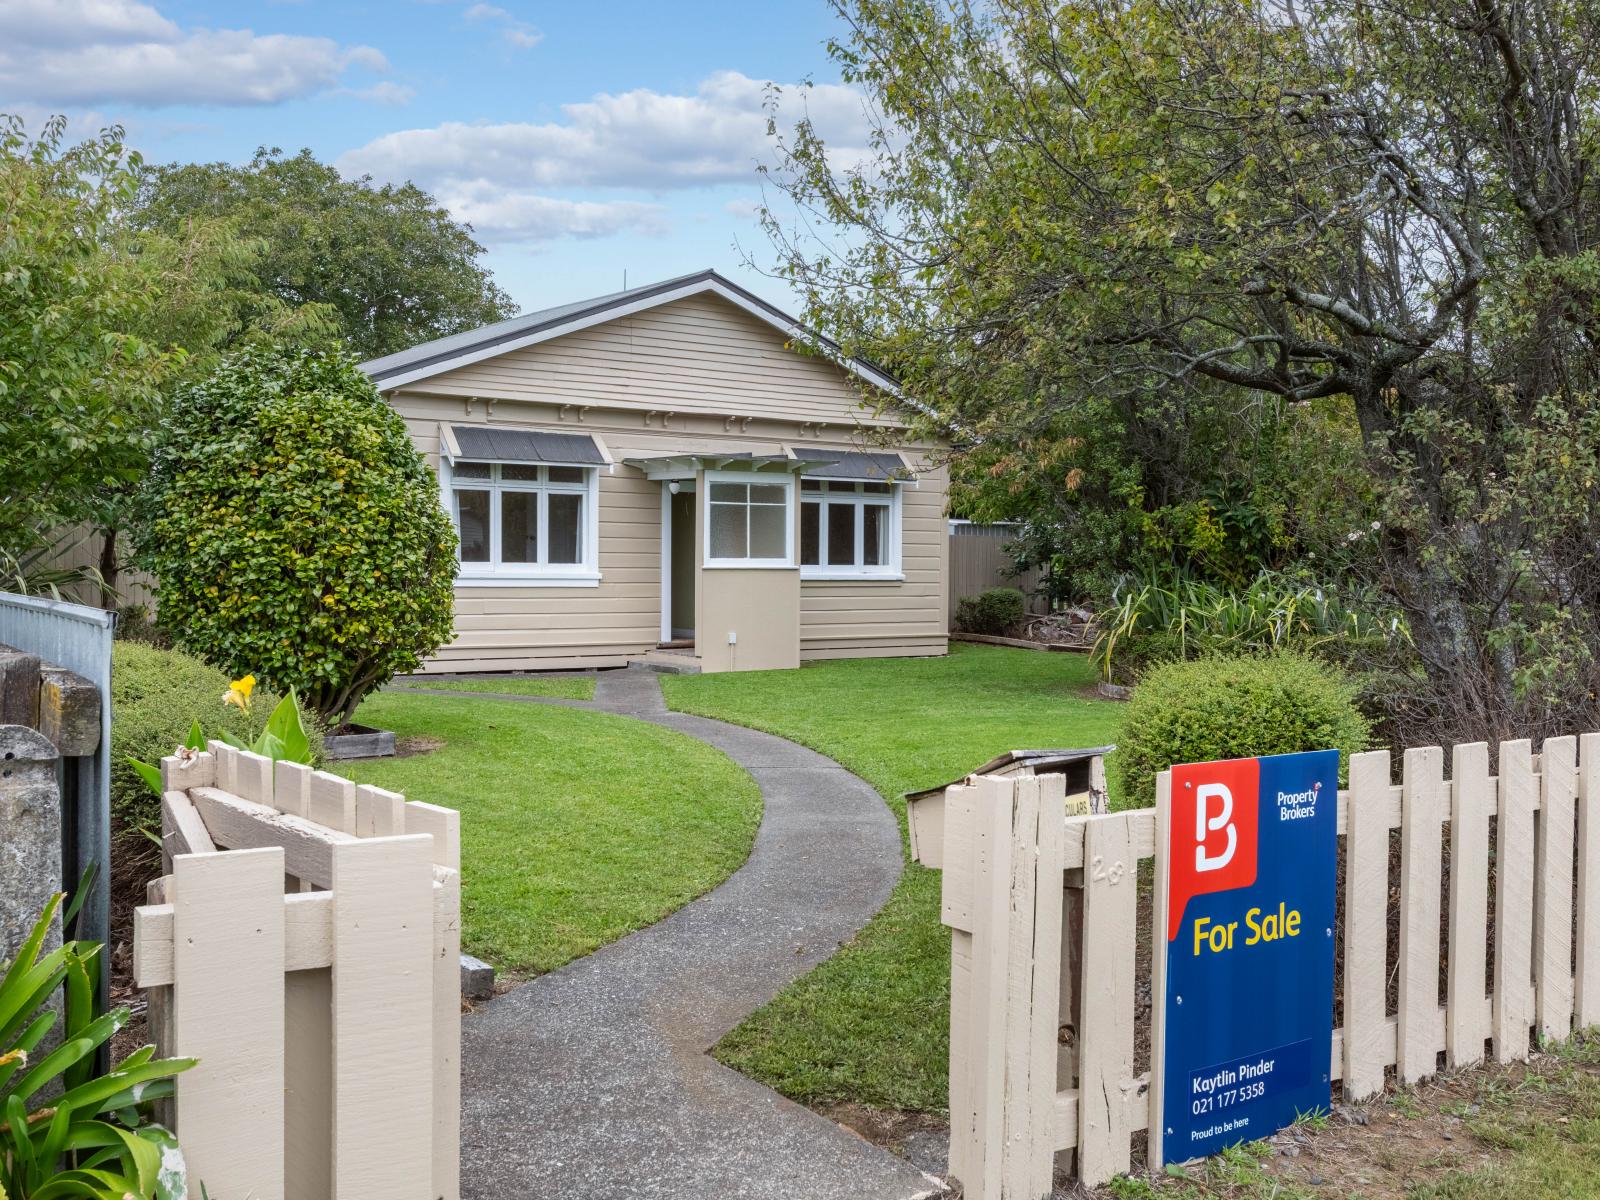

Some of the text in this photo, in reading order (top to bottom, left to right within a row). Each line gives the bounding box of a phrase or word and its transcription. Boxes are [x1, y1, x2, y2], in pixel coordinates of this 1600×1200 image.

[1277, 789, 1318, 807] Property
[1280, 804, 1315, 821] Brokers
[1195, 783, 1237, 872] B
[1194, 902, 1300, 956] For Sale
[1193, 1059, 1275, 1094] Kaytlin Pinder
[1192, 1081, 1265, 1115] 021 177 5358
[1191, 1118, 1249, 1141] Proud to be here
